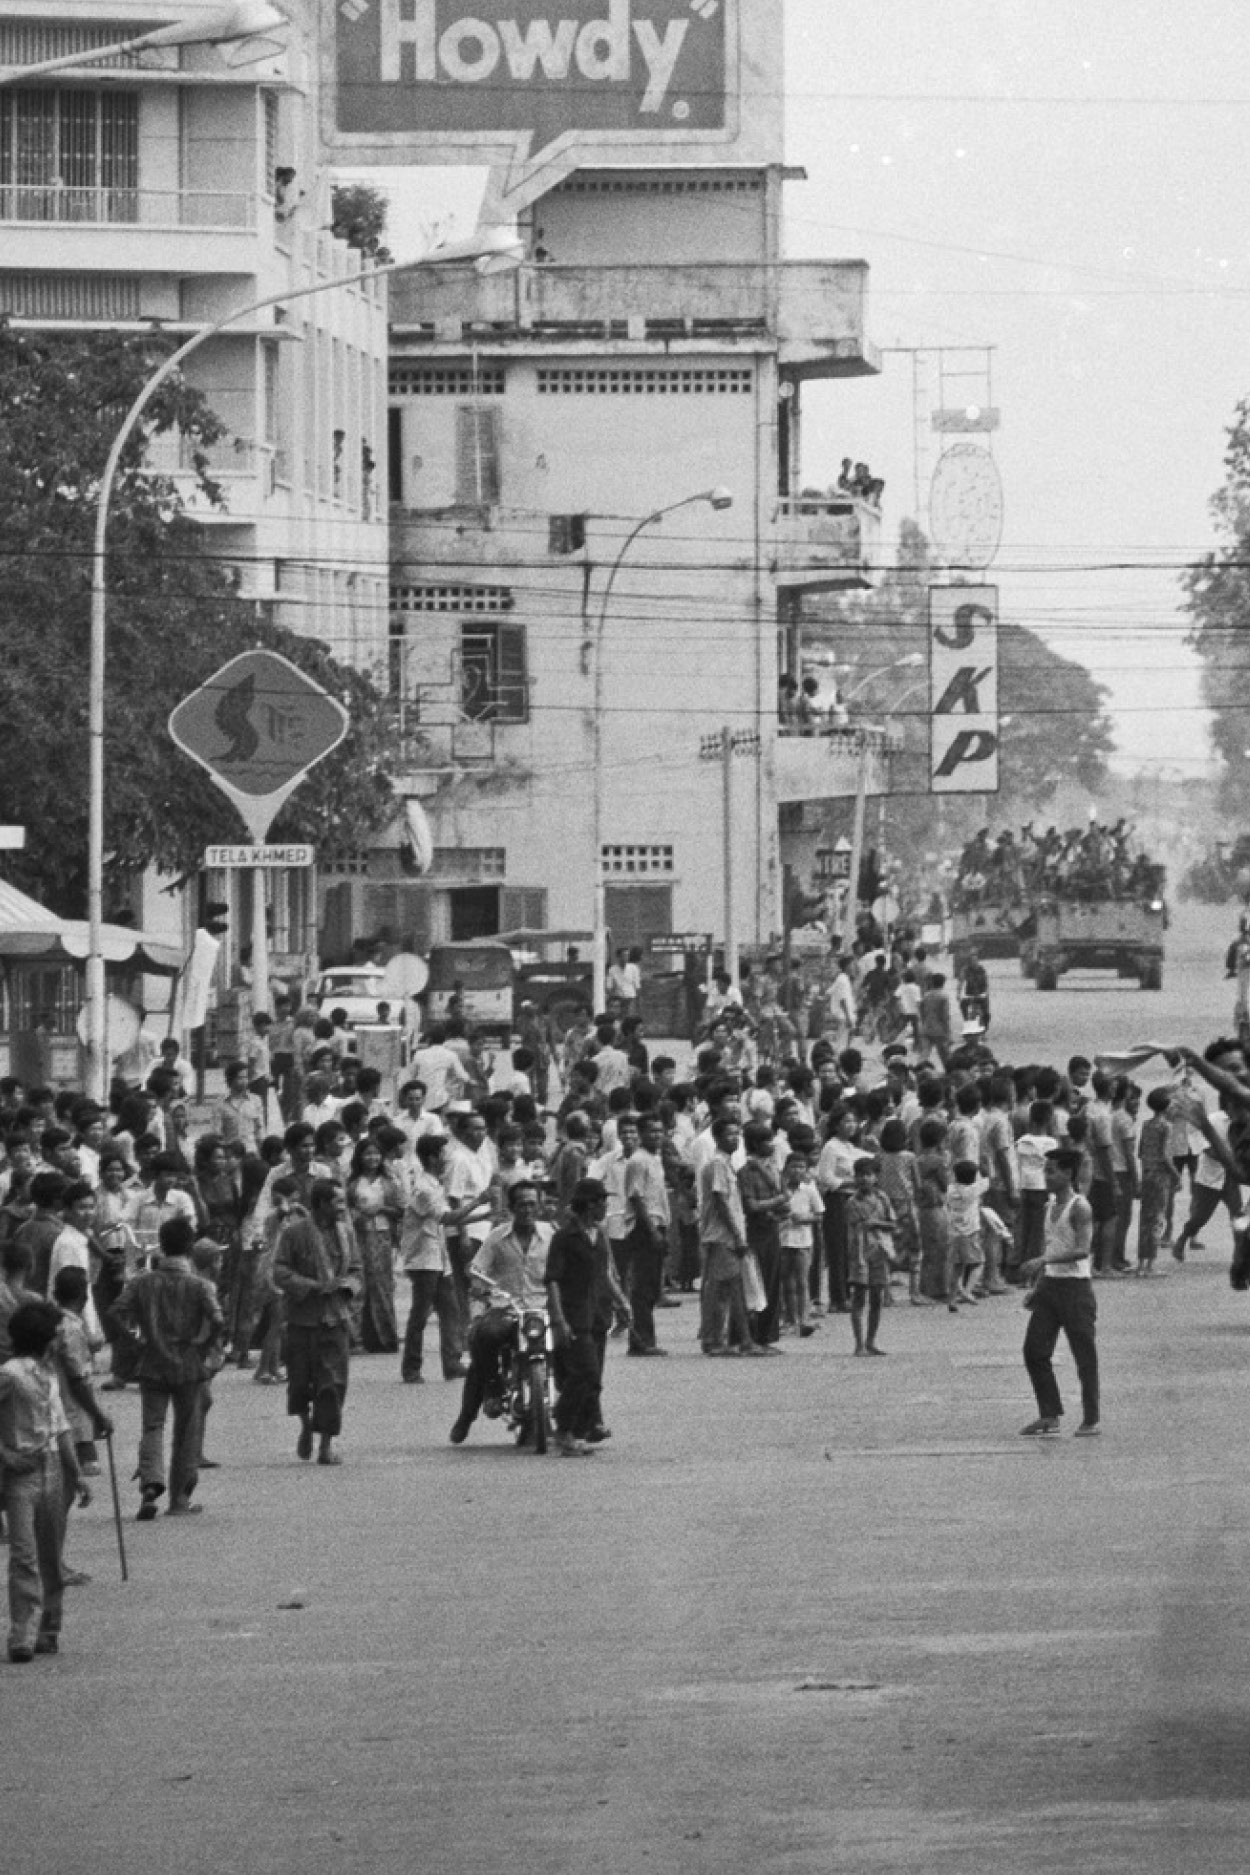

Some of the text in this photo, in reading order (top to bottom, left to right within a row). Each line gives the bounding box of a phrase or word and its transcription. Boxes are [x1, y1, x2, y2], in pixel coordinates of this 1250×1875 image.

[934, 603, 998, 776] SKP
[209, 848, 308, 863] TELA KHMER
